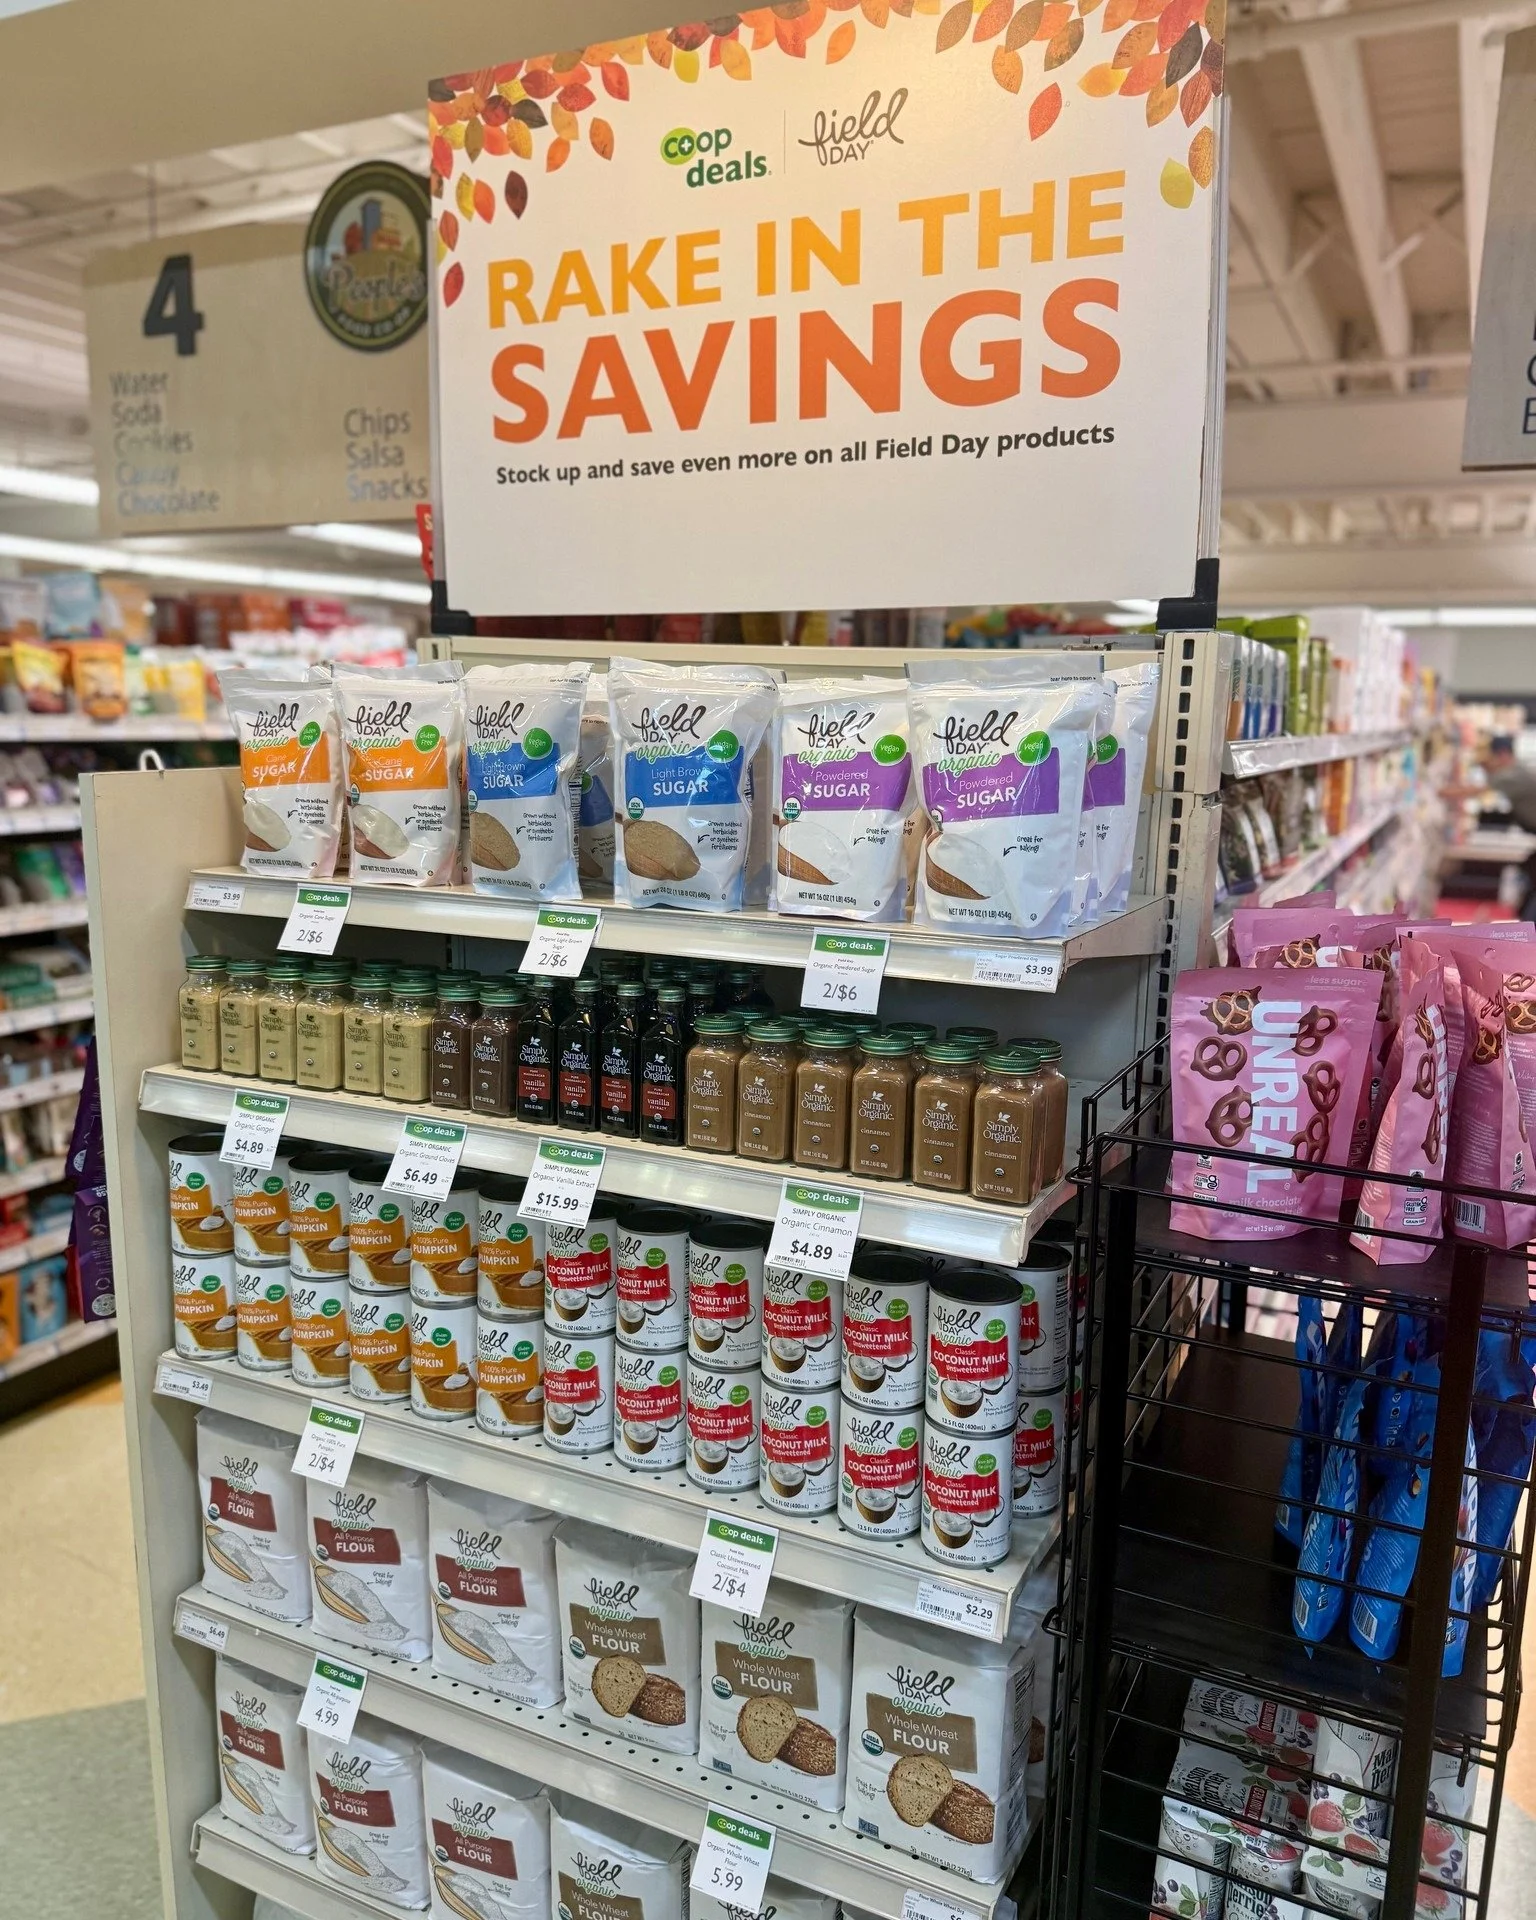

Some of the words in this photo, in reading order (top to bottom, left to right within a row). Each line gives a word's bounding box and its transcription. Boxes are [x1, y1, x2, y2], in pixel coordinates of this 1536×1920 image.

[798, 88, 909, 166] field
[830, 143, 872, 165] DAY
[687, 151, 767, 188] deals
[487, 229, 722, 329] RAKE
[756, 208, 861, 297] IN
[899, 170, 1126, 277] THE
[143, 254, 205, 357] 4
[490, 277, 1121, 444] SAVINGS
[109, 371, 169, 396] Water
[111, 401, 162, 428] Soda
[343, 408, 410, 440] Chips
[346, 442, 404, 470] Salsa
[496, 463, 550, 485] Stock
[557, 466, 581, 486] up
[587, 459, 624, 478] and
[630, 459, 675, 476] save
[681, 453, 731, 473] even
[738, 448, 797, 470] more
[804, 448, 833, 464] on
[840, 440, 867, 462] all
[876, 436, 932, 460] Field
[941, 432, 990, 459] Day
[997, 424, 1116, 458] products
[346, 472, 427, 502] Snacks
[117, 489, 220, 516] Chocolate
[348, 700, 412, 733] field
[469, 700, 525, 738] field
[632, 703, 707, 743] field
[482, 728, 503, 740] DAY
[933, 710, 1019, 754] field
[956, 741, 985, 755] DAY
[252, 760, 297, 779] SUGAR
[938, 753, 1001, 773] organic
[365, 767, 414, 782] SUGAR
[483, 774, 524, 789] SUGAR
[651, 767, 676, 782] Light
[815, 769, 869, 781] Powdered
[959, 772, 1013, 790] Powdered
[653, 779, 709, 796] SUGAR
[813, 782, 871, 799] SUGAR
[957, 787, 1016, 809] SUGAR
[223, 892, 241, 901] $3.99
[322, 894, 340, 902] deals
[567, 916, 587, 925] deals
[959, 908, 967, 916] WT
[968, 909, 975, 917] 16
[975, 910, 981, 918] OZ
[997, 910, 1012, 921] 454g
[297, 930, 323, 944] 2/$6
[849, 941, 873, 951] deals
[537, 953, 568, 968] 2/$6
[813, 961, 833, 970] Organic
[861, 966, 876, 974] Sugar
[1025, 964, 1053, 976] $3.99
[1310, 976, 1330, 985] less
[823, 982, 857, 1001] 2/$6
[645, 1062, 673, 1076] Simply
[261, 1099, 280, 1109] deals
[647, 1097, 670, 1107] vanilla
[1245, 1001, 1301, 1194] UNREAL
[861, 1100, 892, 1113] Simply
[434, 1127, 456, 1137] deals
[860, 1127, 891, 1137] cinnamon
[986, 1120, 1019, 1135] Simply
[235, 1139, 263, 1154] $4.89
[409, 1140, 427, 1149] SIMPLY
[428, 1143, 452, 1153] ORGANIC
[571, 1149, 594, 1160] deals
[985, 1149, 1017, 1160] cinnamon
[403, 1168, 438, 1185] $6.49
[544, 1163, 563, 1172] SIMPLY
[564, 1167, 590, 1177] ORGANIC
[532, 1172, 555, 1182] Organic
[556, 1176, 575, 1185] Vanilla
[576, 1179, 596, 1188] Extract
[536, 1191, 579, 1211] $15.99
[822, 1193, 850, 1205] deals
[235, 1206, 277, 1216] PUMPKIN
[792, 1207, 816, 1217] SIMPLY
[816, 1212, 847, 1223] ORGANIC
[781, 1216, 811, 1229] Organic
[812, 1222, 853, 1236] Cinnamon
[412, 1244, 458, 1255] PUMPKIN
[790, 1239, 833, 1260] $4.89
[933, 1351, 979, 1366] COCONUT
[981, 1352, 1006, 1364] MILK
[192, 1380, 209, 1392] $3.49
[480, 1372, 527, 1384] PUMPKIN
[334, 1417, 352, 1428] deals
[308, 1453, 336, 1472] 2/$4
[926, 1480, 970, 1496] COCONUT
[971, 1485, 997, 1498] MILK
[228, 1502, 255, 1518] FLOUR
[740, 1531, 763, 1545] deals
[336, 1542, 376, 1553] FLOUR
[716, 1561, 738, 1573] Coconut
[739, 1567, 750, 1576] Milk
[468, 1573, 498, 1586] Purpose
[712, 1573, 746, 1598] 2/$4
[459, 1580, 498, 1597] FLOUR
[965, 1603, 993, 1620] $2.29
[208, 1626, 226, 1639] $6.49
[339, 1671, 356, 1683] deals
[733, 1657, 764, 1674] Whole
[766, 1664, 801, 1681] Wheat
[740, 1671, 794, 1696] FLOUR
[887, 1665, 955, 1707] field
[315, 1707, 339, 1727] 4.99
[885, 1712, 920, 1731] Whole
[921, 1723, 959, 1741] Wheat
[892, 1728, 951, 1756] FLOUR
[738, 1827, 760, 1841] deals
[706, 1841, 726, 1853] Organic
[726, 1848, 742, 1860] Whole
[743, 1855, 760, 1867] Wheat
[724, 1857, 738, 1867] Flour
[711, 1867, 743, 1892] 5.99
